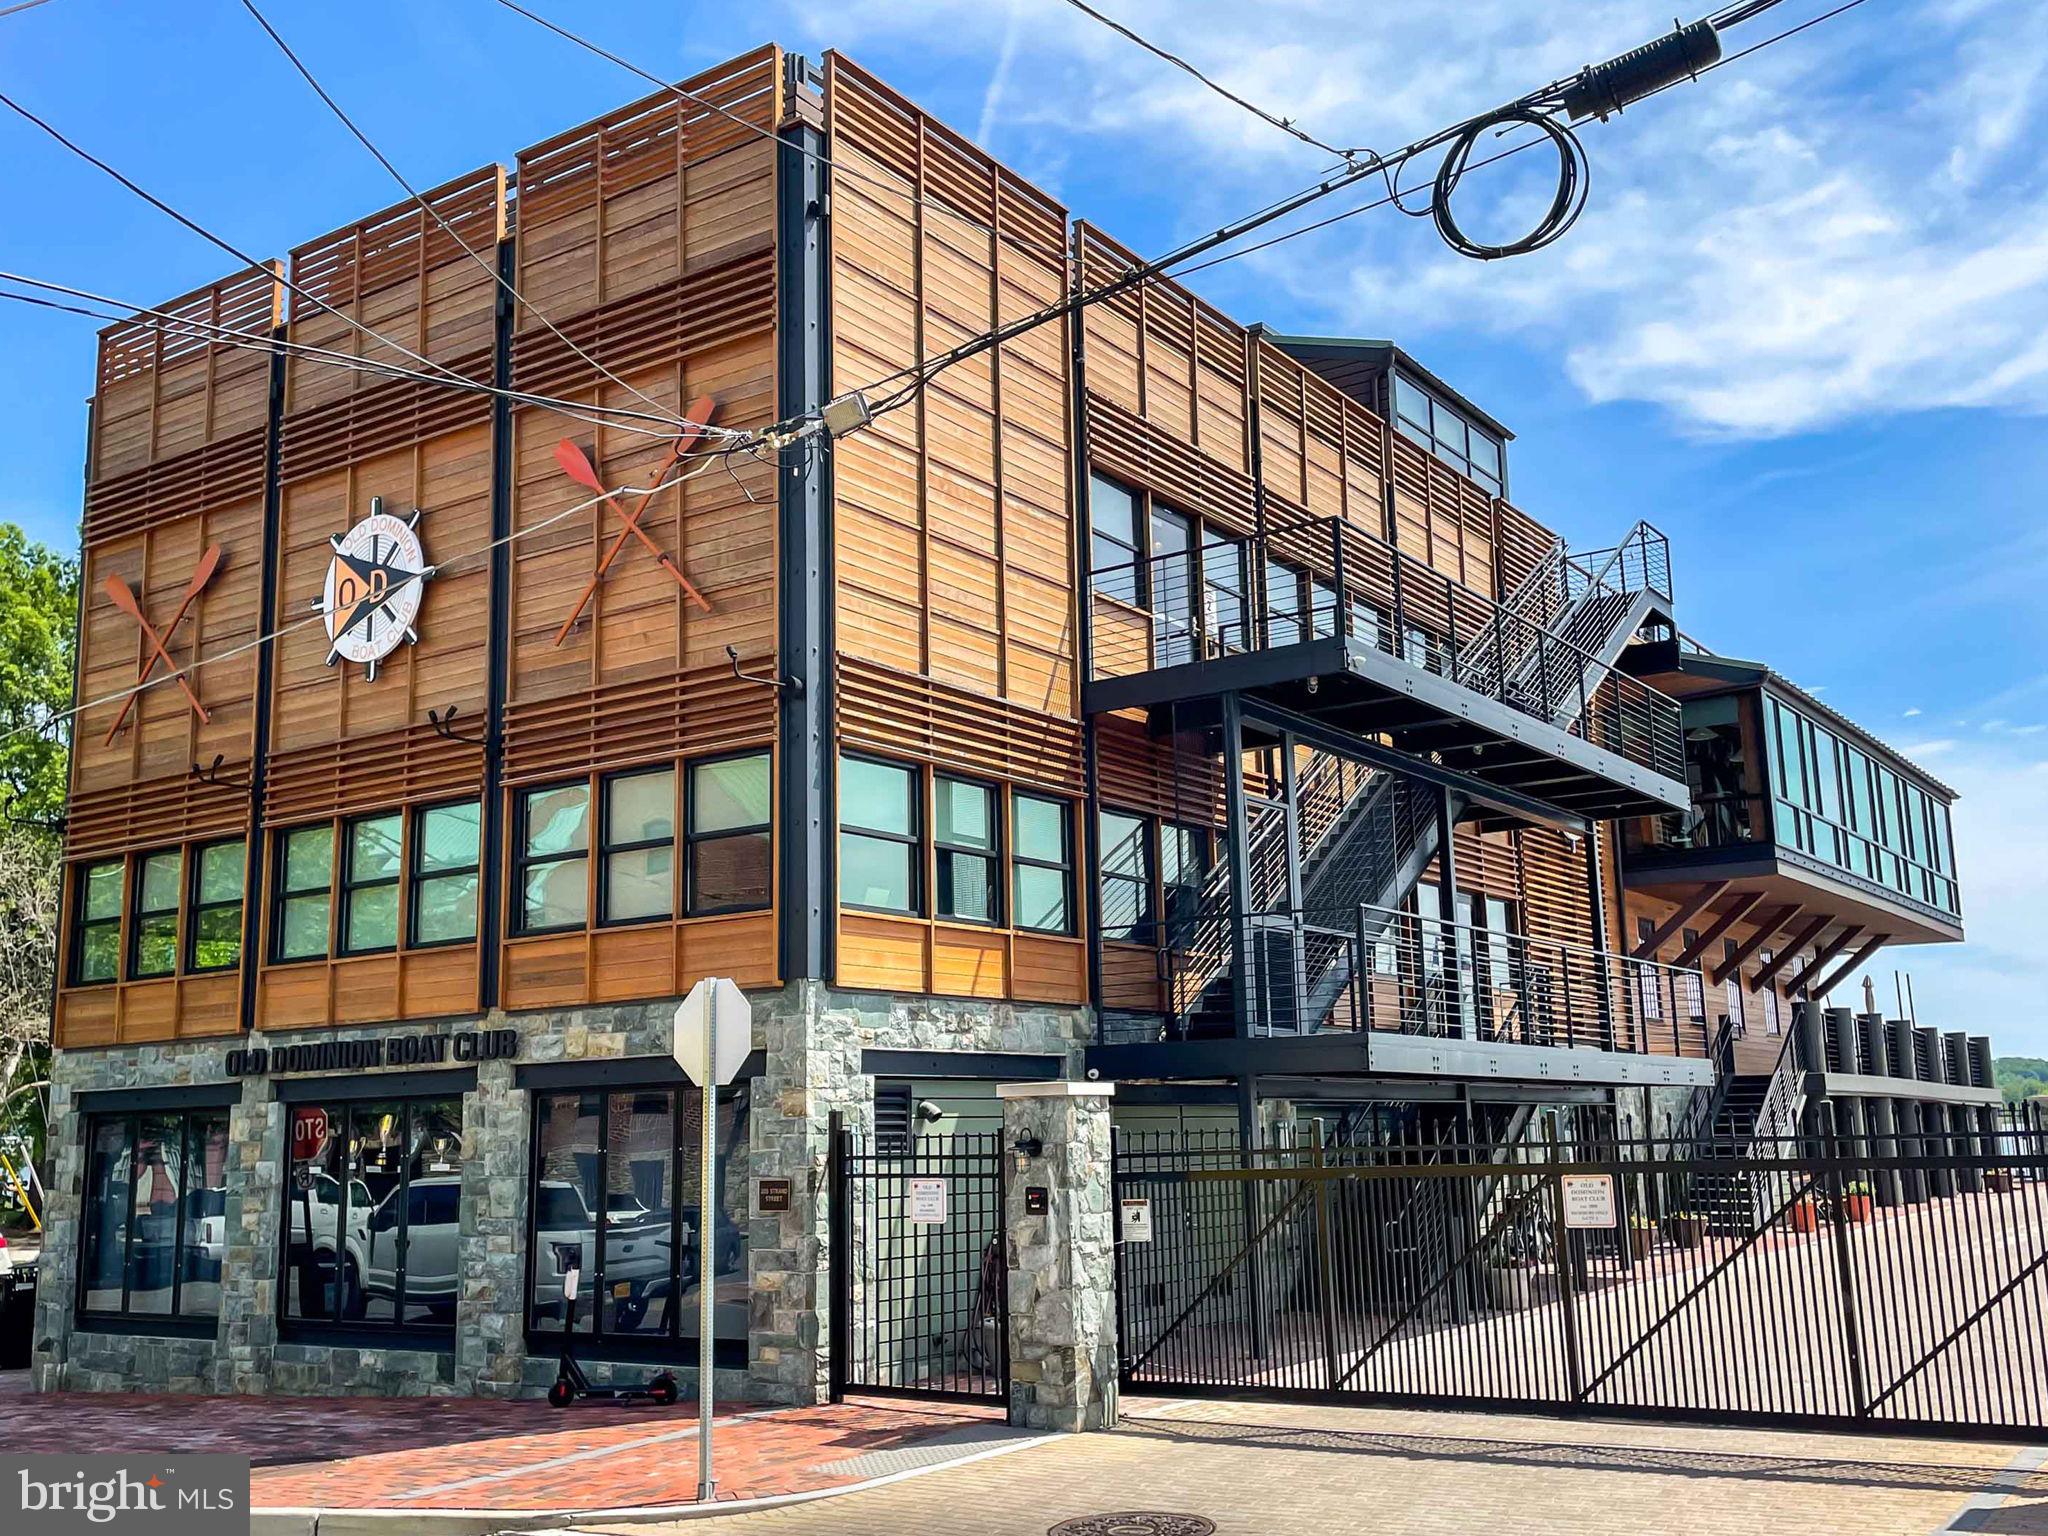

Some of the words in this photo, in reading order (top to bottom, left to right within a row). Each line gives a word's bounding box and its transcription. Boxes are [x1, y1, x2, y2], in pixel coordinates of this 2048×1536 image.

[344, 524, 367, 550] OLD
[371, 517, 416, 562] DOMINION
[352, 641, 382, 659] BOAT
[387, 602, 413, 643] CLUB
[225, 1048, 268, 1077] OLD
[271, 1040, 381, 1073] DOMINION
[386, 1034, 449, 1066] BOAT
[453, 1029, 517, 1061] CLUB
